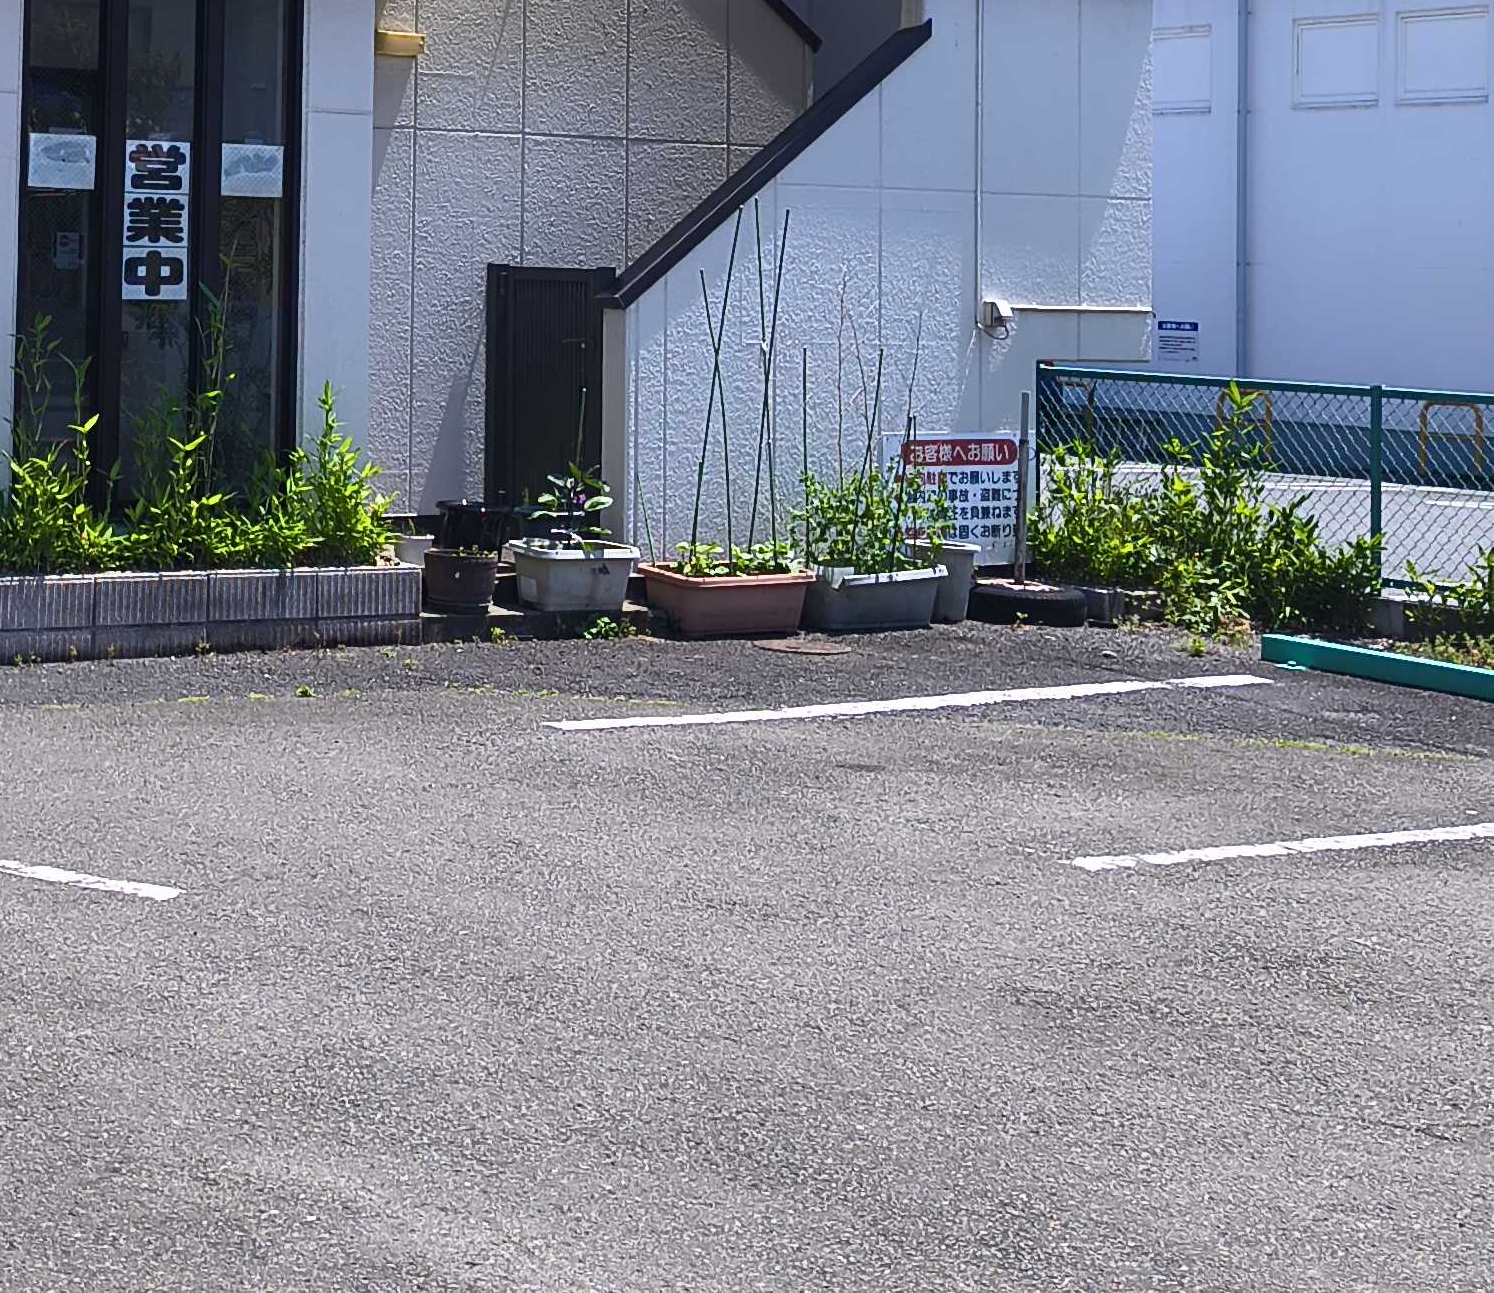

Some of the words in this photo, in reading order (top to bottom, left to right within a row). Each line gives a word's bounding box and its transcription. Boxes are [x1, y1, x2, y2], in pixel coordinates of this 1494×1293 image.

[124, 143, 187, 297] 営業中
[910, 443, 1009, 463] お客様へお願い
